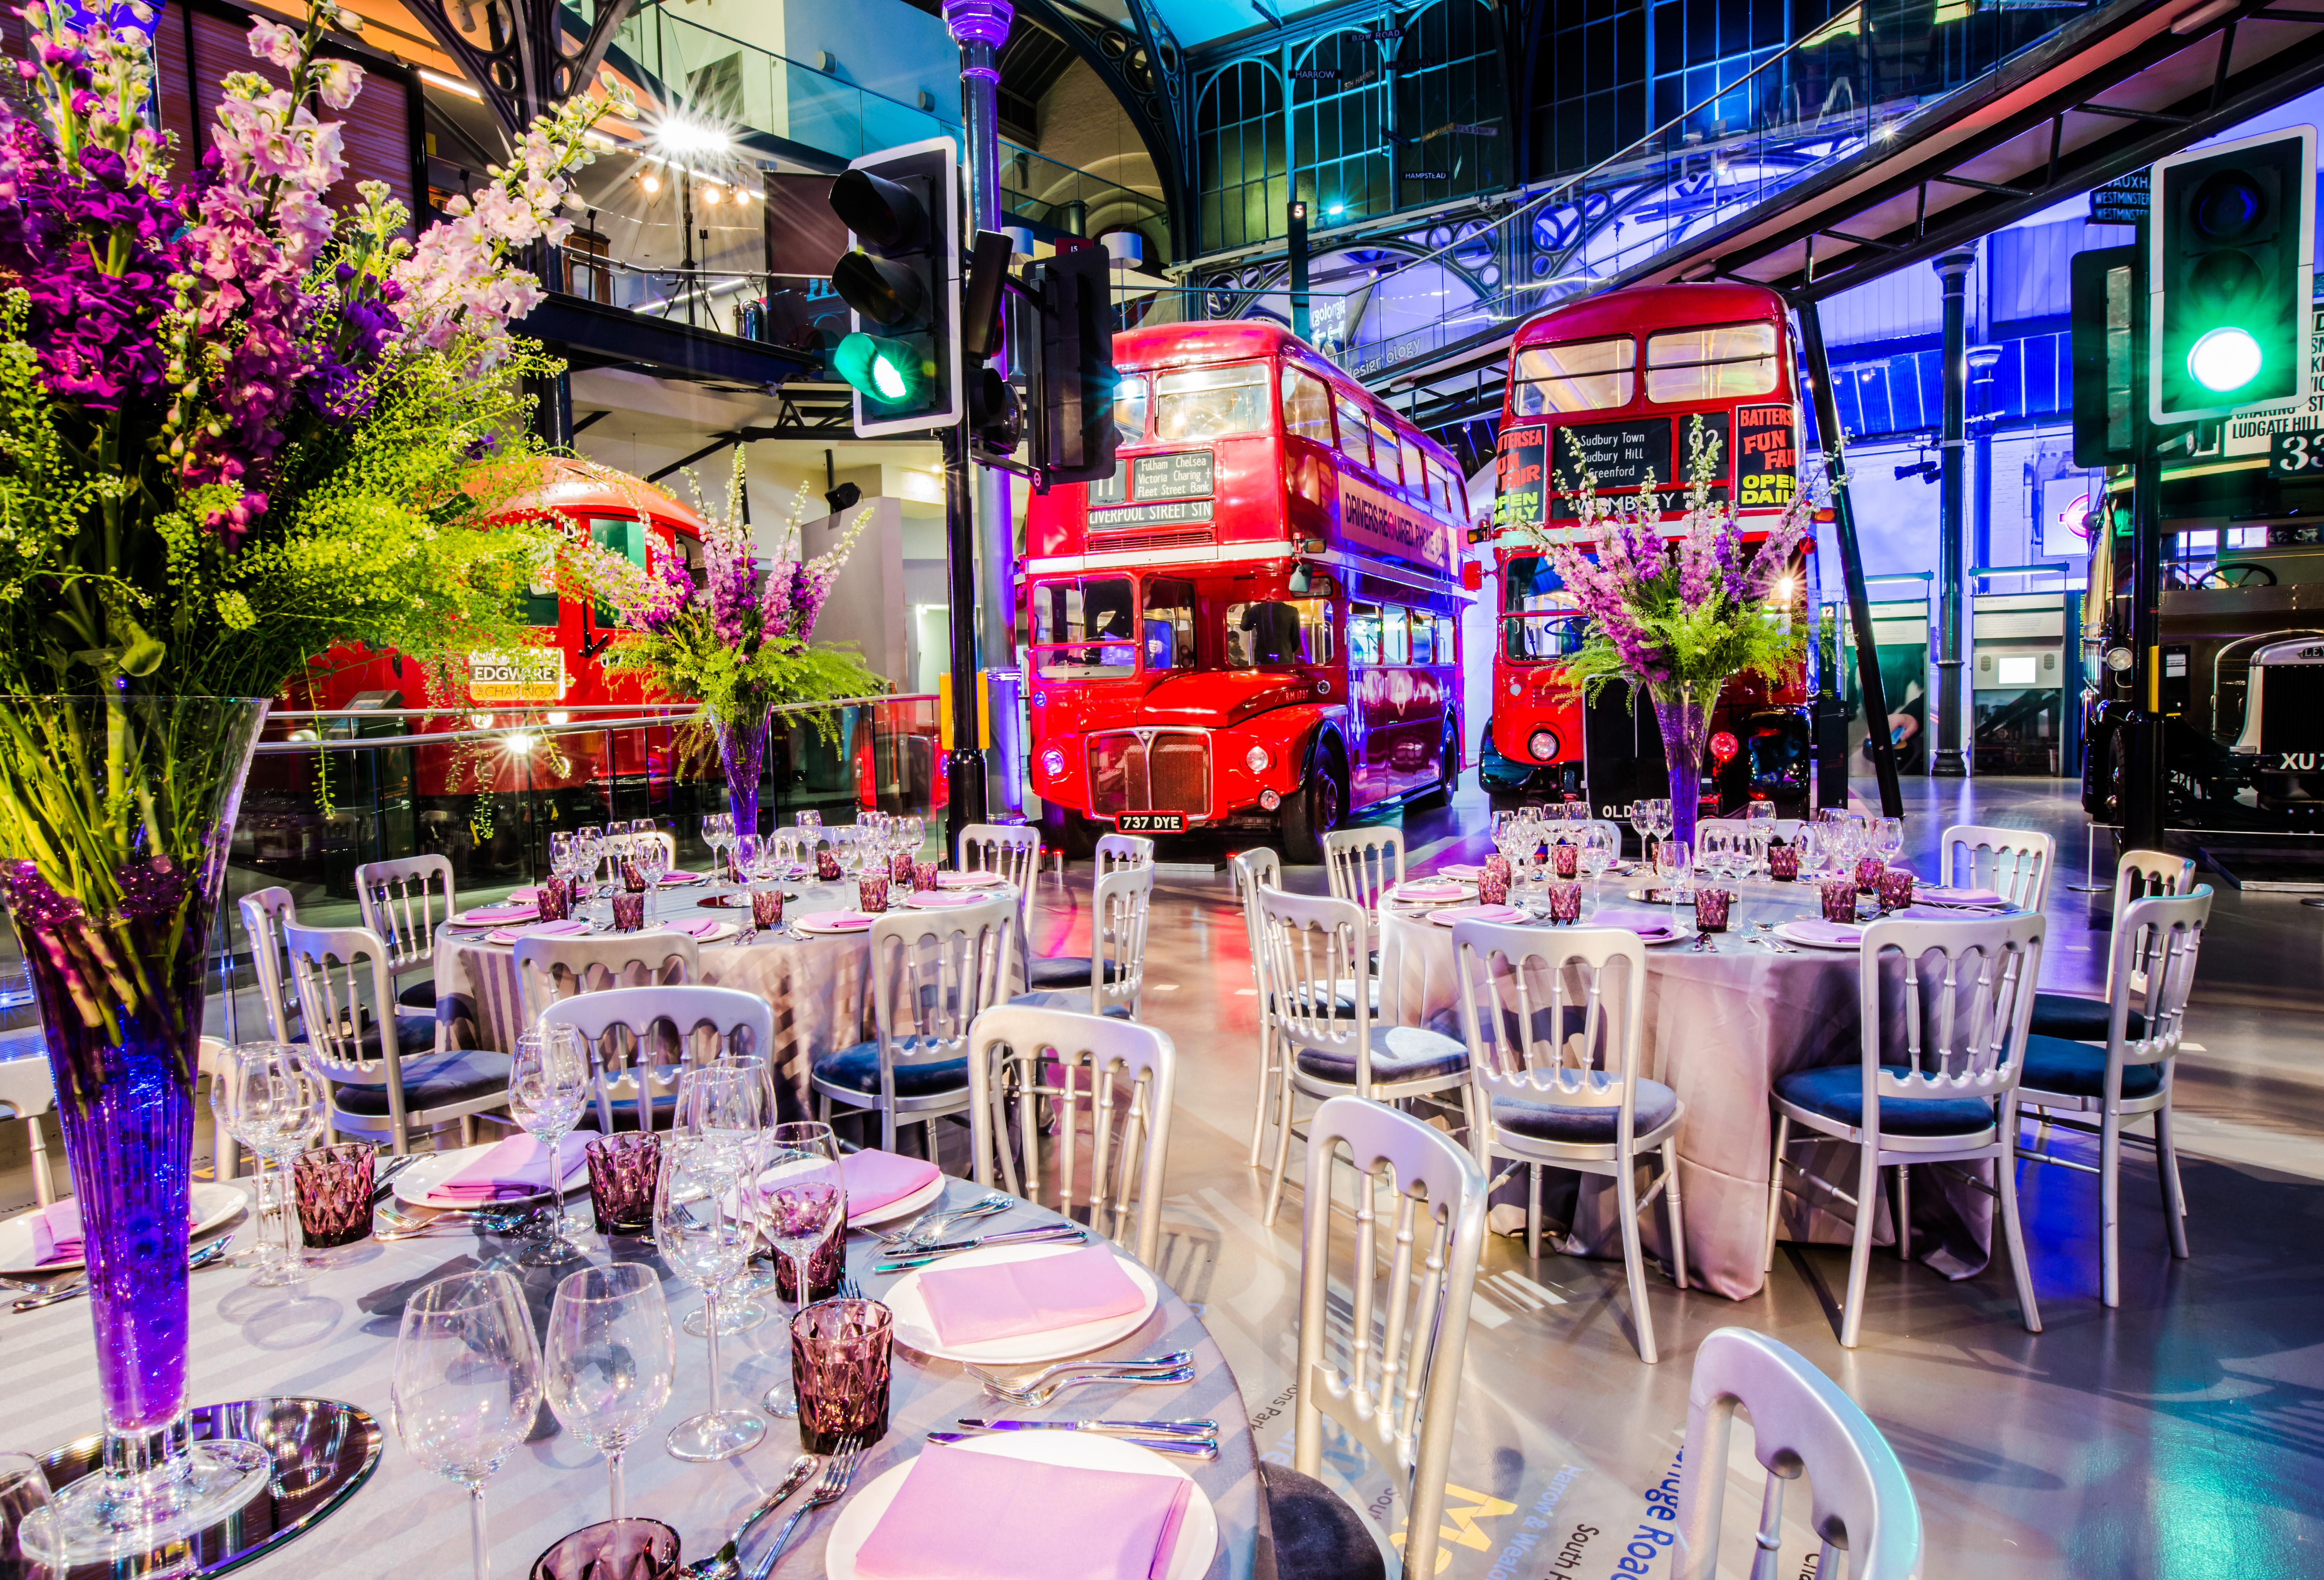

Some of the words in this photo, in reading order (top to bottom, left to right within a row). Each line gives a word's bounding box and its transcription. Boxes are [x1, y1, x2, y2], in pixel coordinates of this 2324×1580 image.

[1352, 33, 1373, 41] BOW
[1375, 30, 1400, 39] ROAD
[1296, 70, 1335, 79] HARROW
[2107, 176, 2151, 189] AUXH
[2094, 191, 2151, 205] WESTMINSTER
[1294, 204, 1303, 217] 5
[1740, 408, 1794, 427] BATTERS
[2232, 418, 2289, 439] LUDGATE
[1497, 429, 1542, 454] TTERSEA
[1581, 434, 1618, 447] Sudbury
[1622, 432, 1645, 444] Town
[1743, 429, 1786, 455] FUN
[1141, 460, 1168, 472] Fulham
[1175, 456, 1206, 468] Chelsea
[1496, 451, 1520, 475] UN
[1582, 452, 1618, 464] Sudbury
[1625, 448, 1643, 460] Hill
[1138, 473, 1168, 485] Victoria
[1173, 470, 1201, 482] Charing
[1501, 464, 1541, 492] FAIR
[1138, 486, 1158, 498] Fleet
[1161, 484, 1186, 495] Street
[1190, 481, 1210, 493] Bank
[1089, 507, 1145, 524] LIVERPOOL
[1149, 503, 1186, 520] STREET
[1191, 502, 1211, 517] STN
[1345, 492, 1379, 534] DRIVERS
[1821, 606, 1834, 617] 12
[1286, 692, 1295, 701] RM
[1297, 690, 1309, 699] 1737
[2280, 753, 2315, 770] XU
[1603, 805, 1633, 818] OLD
[1123, 816, 1149, 829] 737
[1154, 816, 1180, 829] DYE
[1272, 1381, 1297, 1406] ons
[1250, 1406, 1282, 1431] Park
[1533, 1464, 1584, 1517] Harrow
[1554, 1523, 1600, 1568] South
